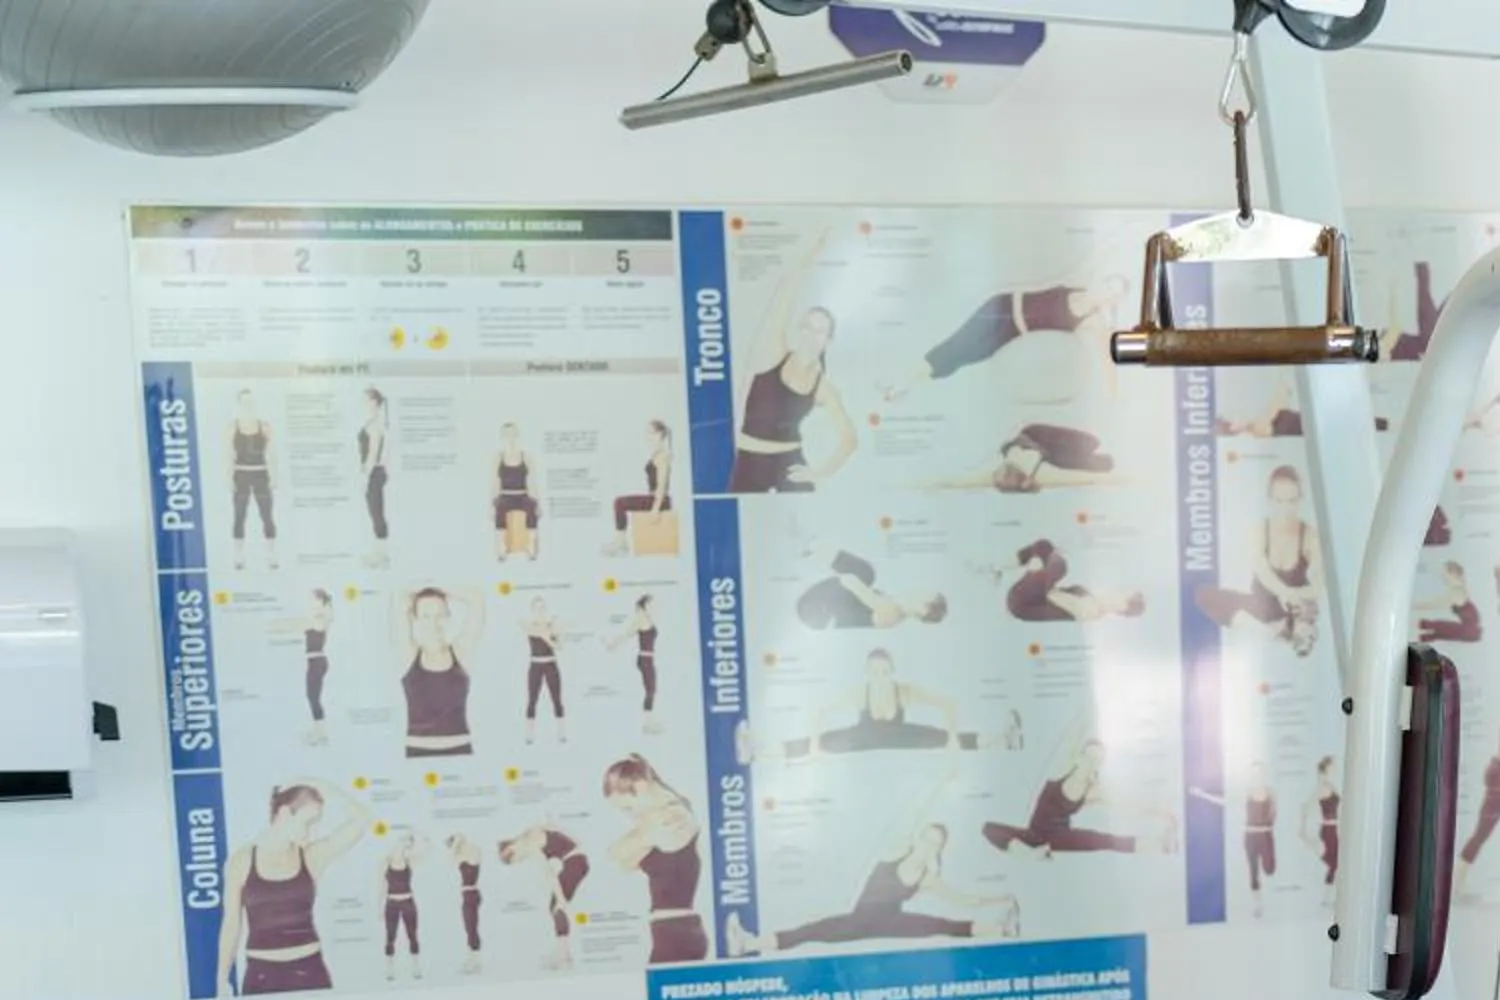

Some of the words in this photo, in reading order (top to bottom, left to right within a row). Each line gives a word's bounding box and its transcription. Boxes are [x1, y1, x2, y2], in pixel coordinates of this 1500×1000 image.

[184, 248, 197, 273] 1
[295, 248, 310, 273] 2
[407, 248, 422, 273] 3
[512, 248, 526, 273] 4
[616, 248, 630, 273] 5
[693, 287, 726, 387] Tronco
[161, 398, 195, 531] Posturas
[1183, 444, 1213, 571] Membros
[181, 589, 214, 752] Superiores
[706, 575, 740, 714] Inferiores
[186, 806, 221, 911] Coluna
[719, 773, 750, 906] Membros
